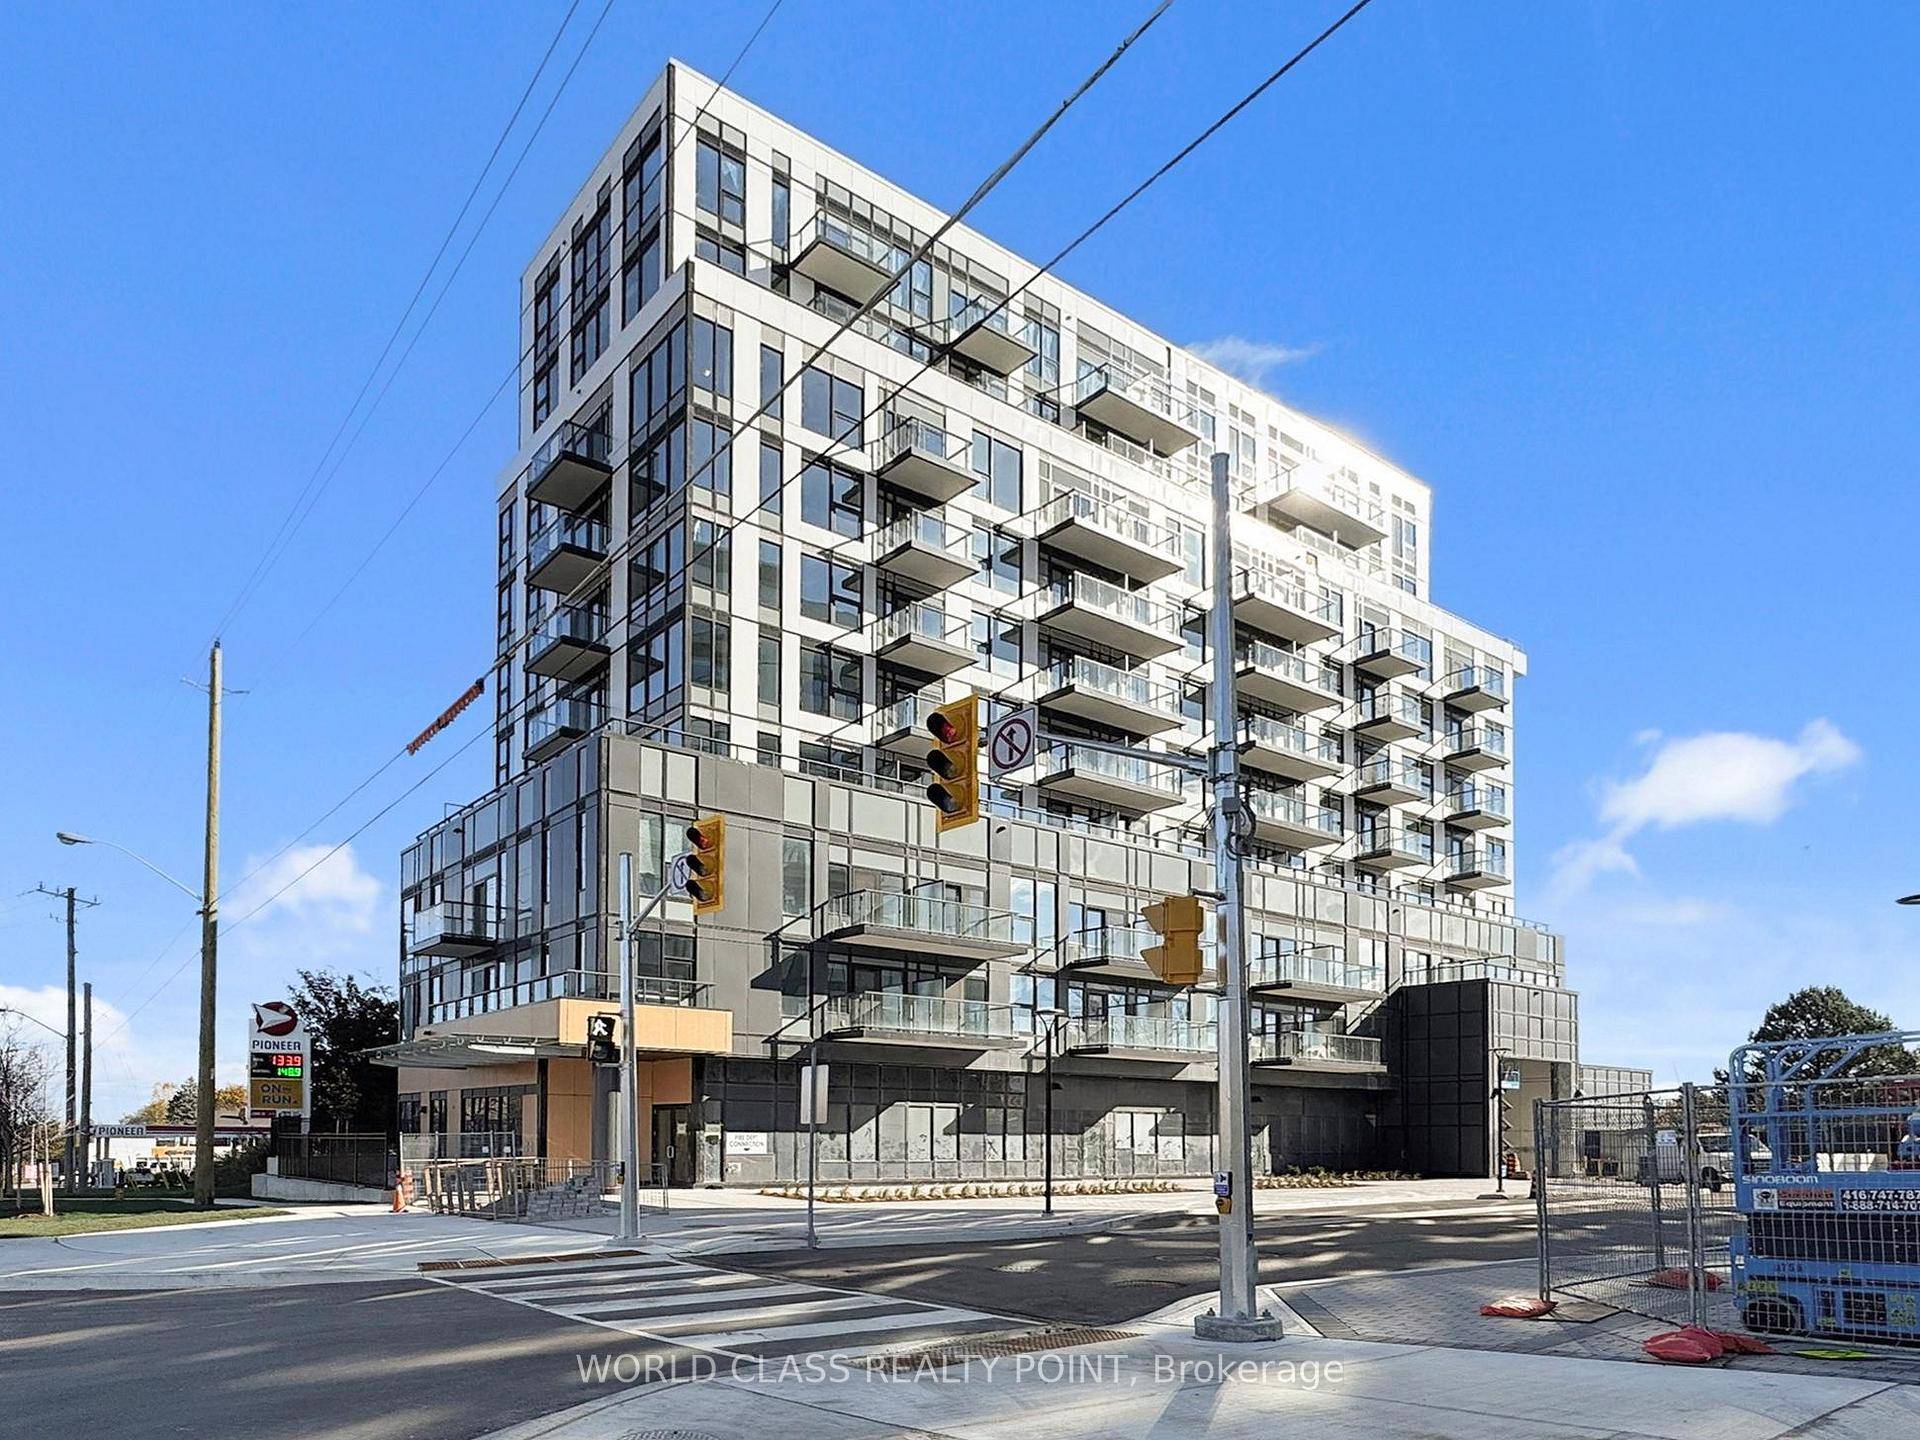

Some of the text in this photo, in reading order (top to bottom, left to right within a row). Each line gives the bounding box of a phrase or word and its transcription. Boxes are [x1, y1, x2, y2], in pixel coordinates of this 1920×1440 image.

[252, 1040, 301, 1050] PIONEER
[261, 1084, 280, 1093] ON
[262, 1095, 292, 1104] RUN
[98, 1126, 144, 1136] PIONEER
